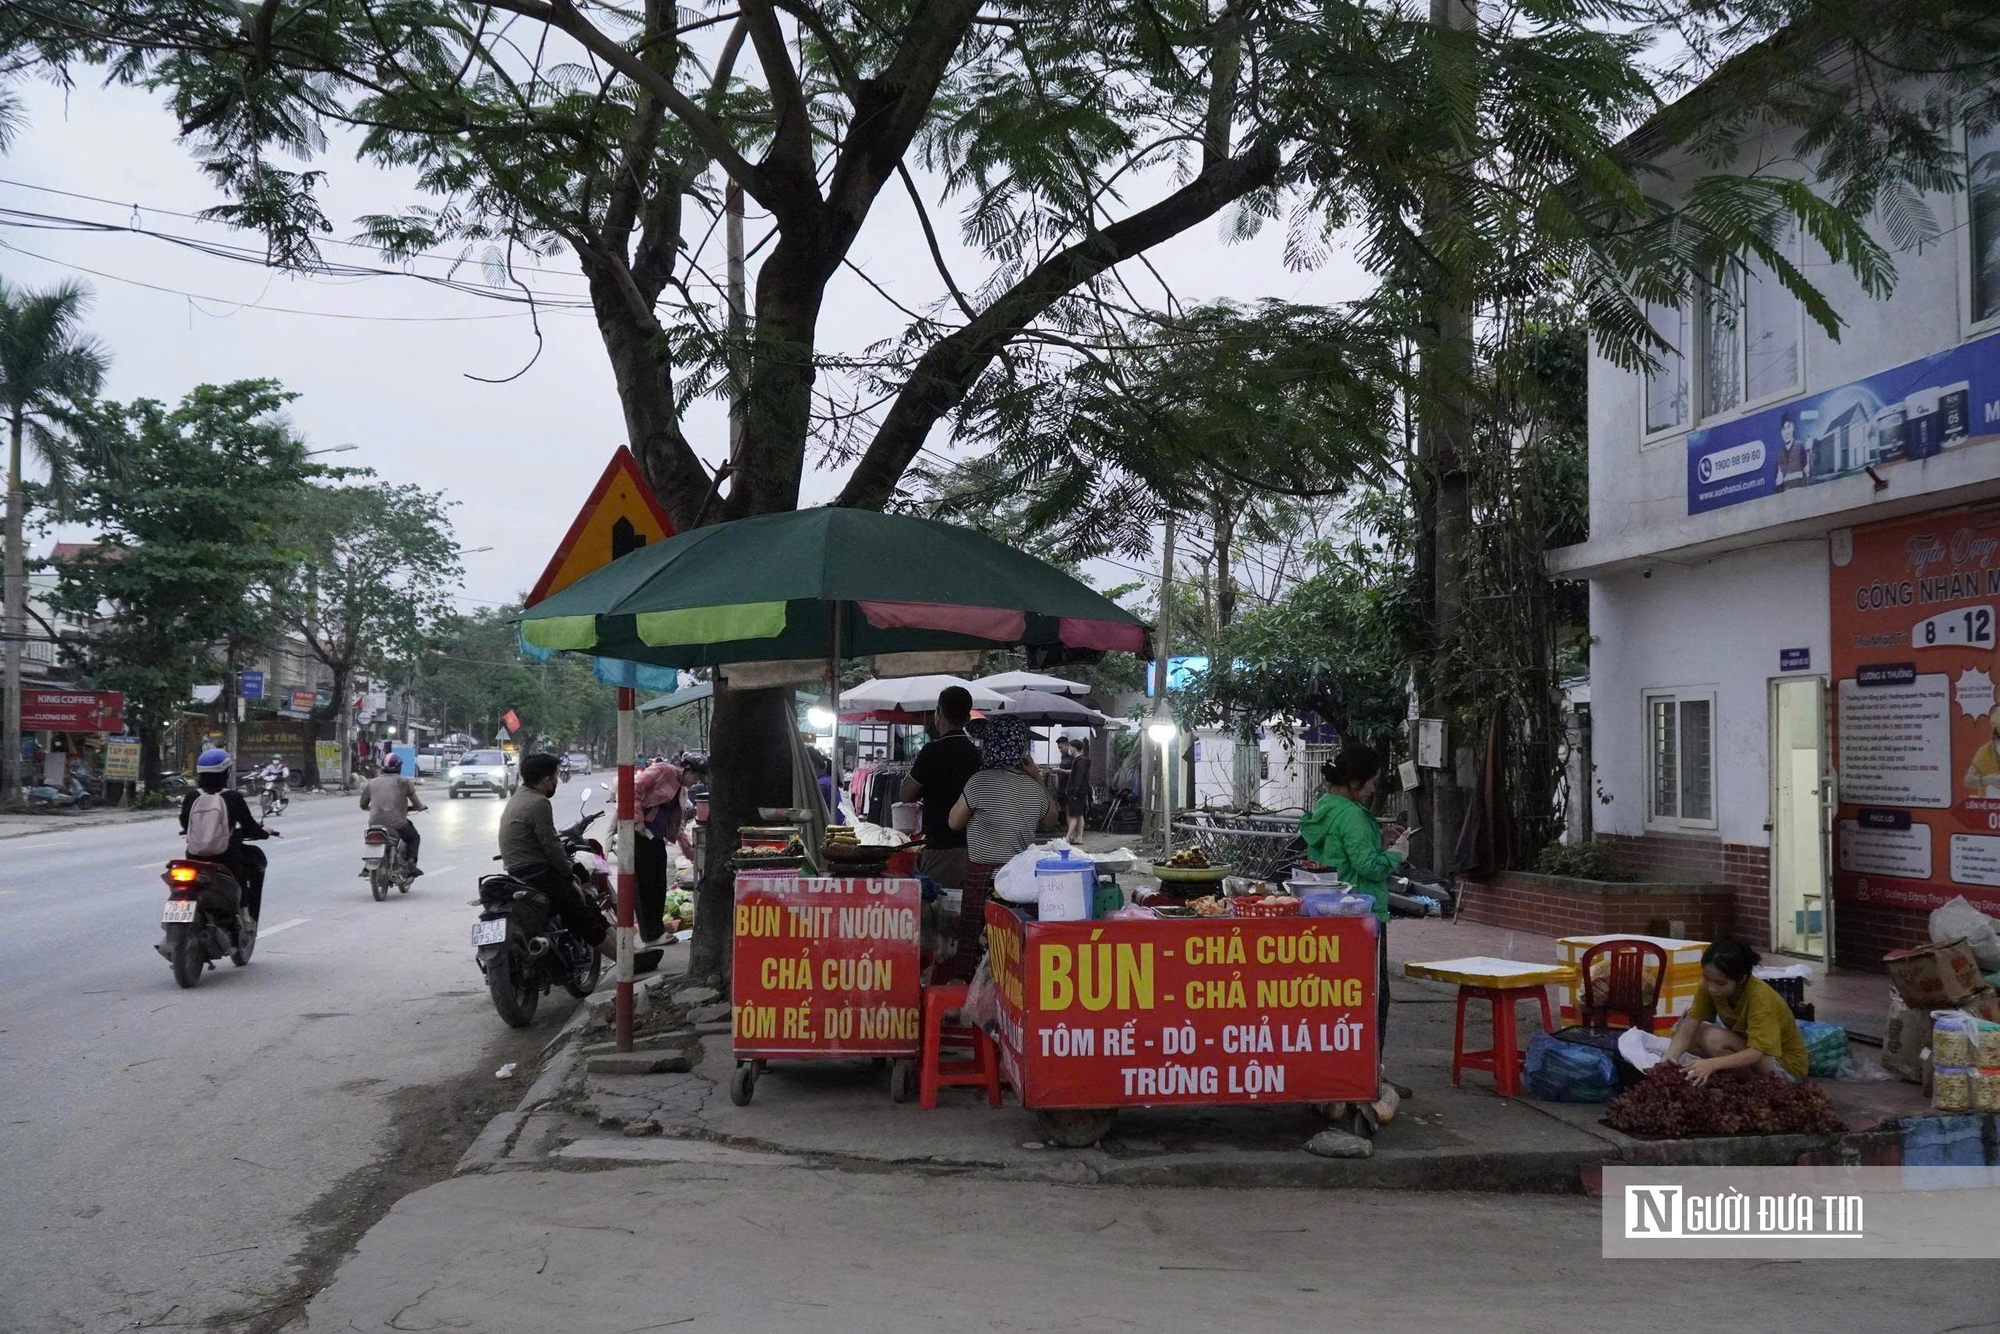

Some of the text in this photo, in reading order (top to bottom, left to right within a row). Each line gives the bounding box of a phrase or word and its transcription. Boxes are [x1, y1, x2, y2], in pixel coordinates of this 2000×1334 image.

[1714, 449, 1761, 471] 1900 98 99 60
[1857, 579, 1913, 612] CÔNG
[1920, 568, 1979, 604] NHÂN
[1925, 621, 1936, 644] 8
[1963, 609, 1990, 642] 12
[38, 695, 95, 704] KING COFFEE
[736, 899, 780, 937] BÚN
[787, 906, 833, 945] THỊT
[1185, 927, 1246, 965] CHẢ
[1257, 925, 1340, 965] CUỐN
[761, 947, 892, 991] CHẢ CUỐN
[1039, 929, 1154, 1011] BÚN
[1185, 970, 1247, 1009] CHẢ
[1257, 973, 1362, 1008] NƯỚNG
[732, 997, 919, 1043] TÔM RẾ, DÒ NÓNG
[1038, 1022, 1094, 1057] TÔM
[1103, 1018, 1137, 1056] RẾ
[1162, 1020, 1196, 1055] DÒ
[1222, 1015, 1270, 1053] CHẢ
[1282, 1018, 1312, 1052] LÁ
[1320, 1013, 1363, 1051] LỐT
[1121, 1059, 1284, 1099] TRỨNG LỘN
